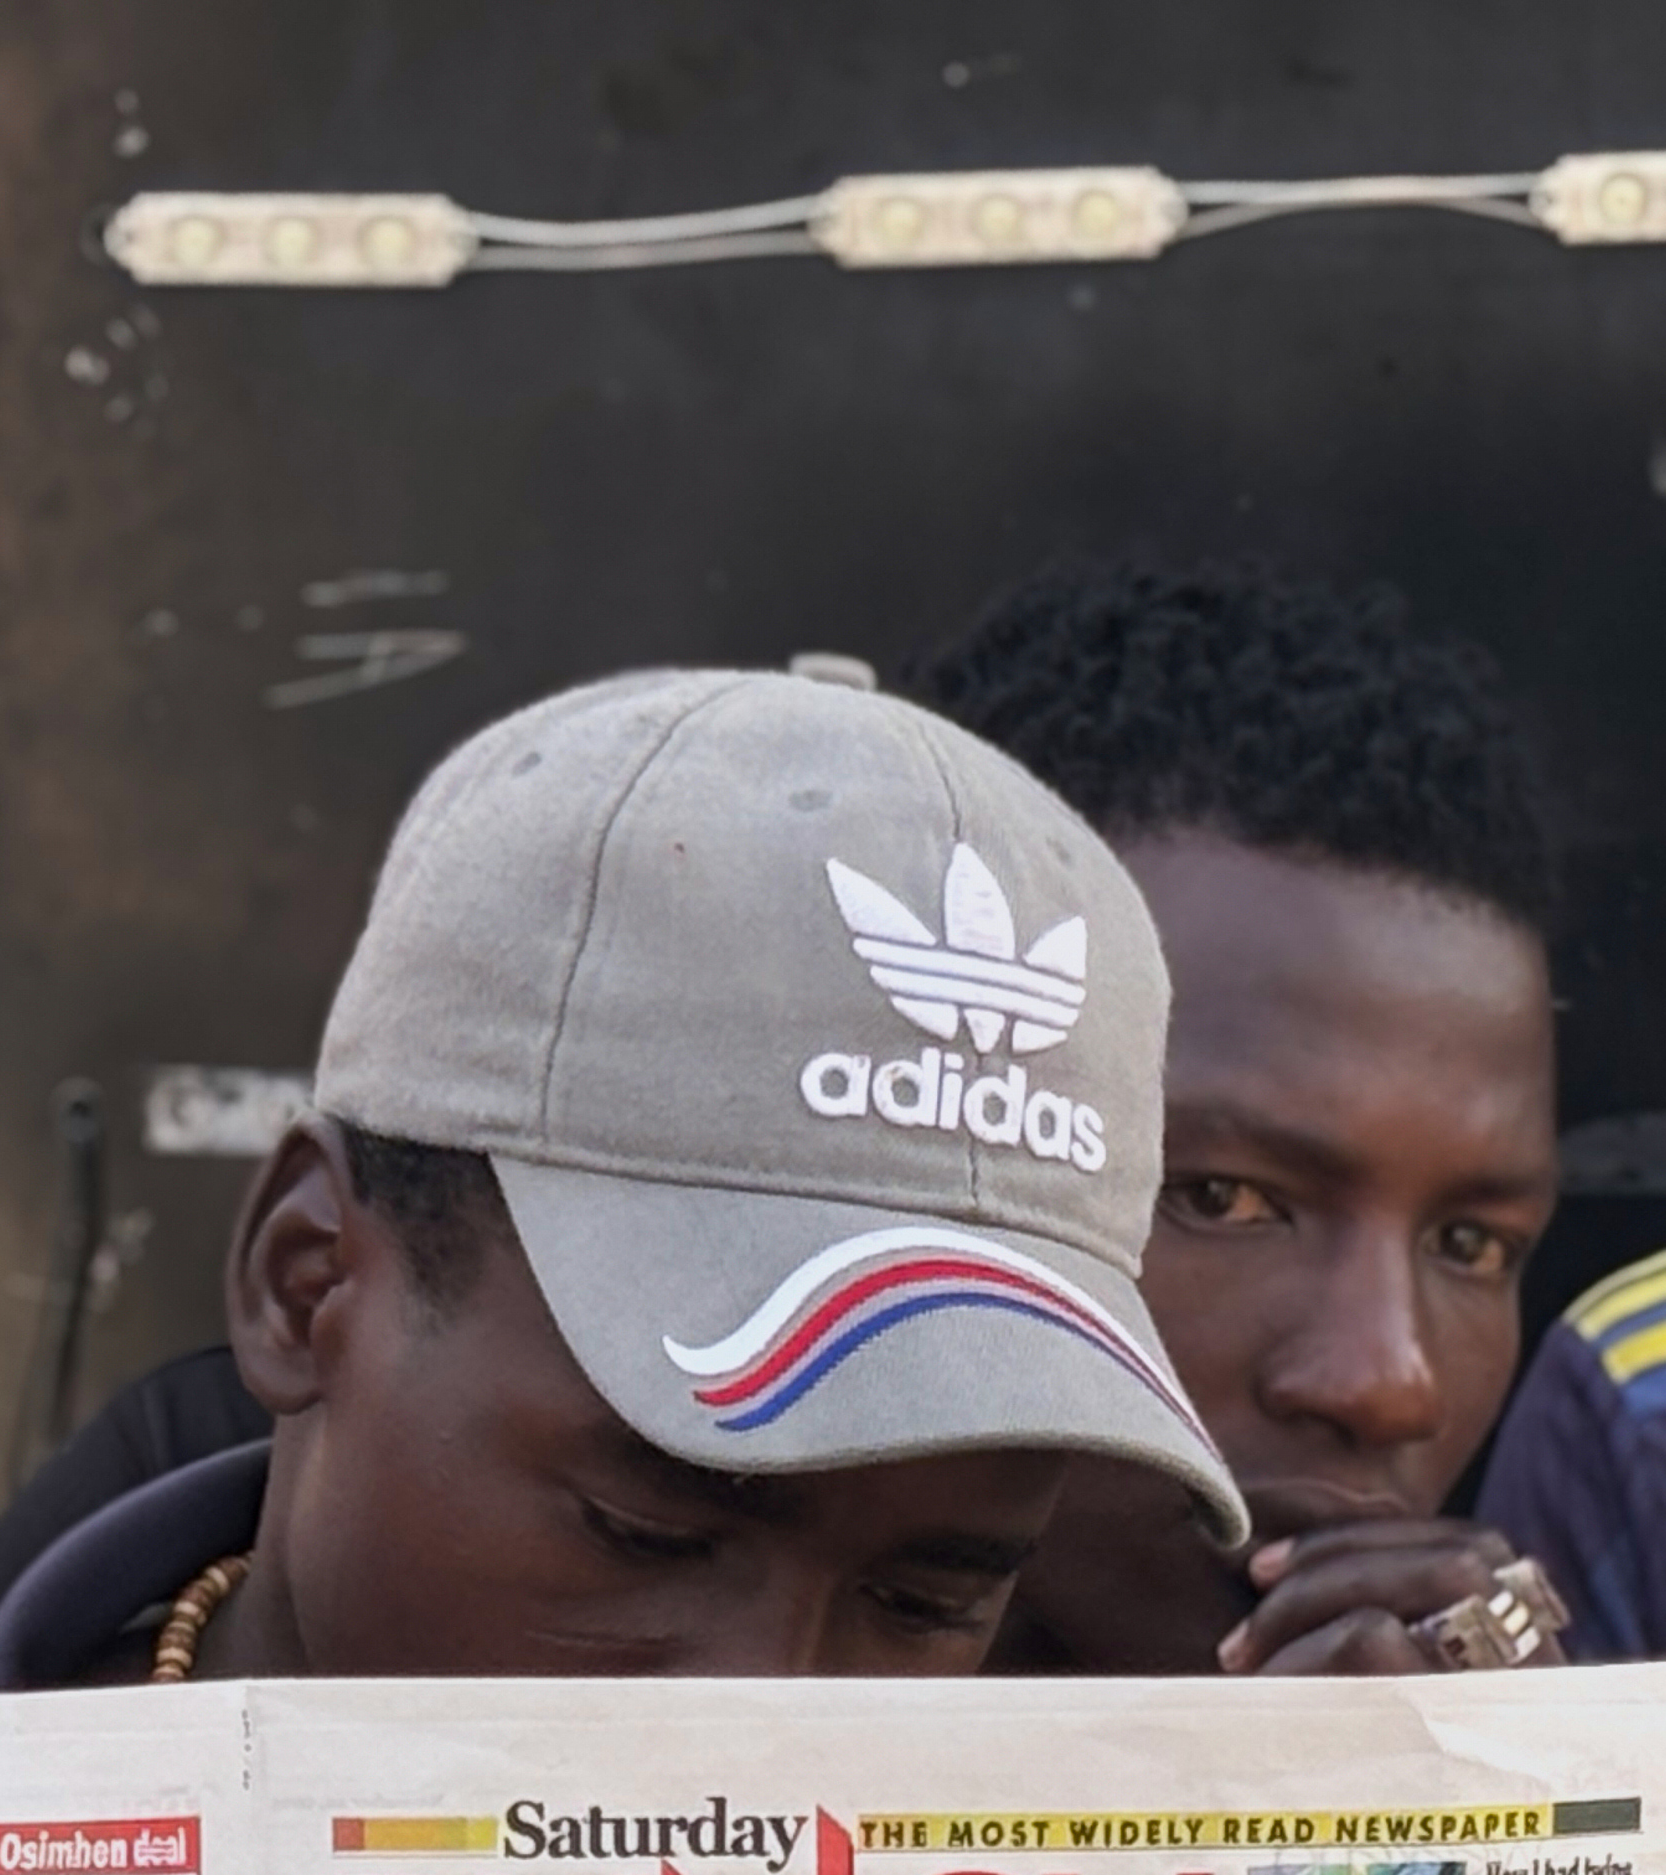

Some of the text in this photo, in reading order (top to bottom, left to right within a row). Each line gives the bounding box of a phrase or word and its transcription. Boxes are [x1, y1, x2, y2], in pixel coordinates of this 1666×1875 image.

[800, 1046, 1106, 1172] adidas
[0, 1831, 127, 1869] Osimhen
[132, 1828, 186, 1867] deal
[504, 1797, 809, 1873] Saturday
[861, 1811, 1541, 1847] THE MOST WIDELY READ NEWSPAPER
